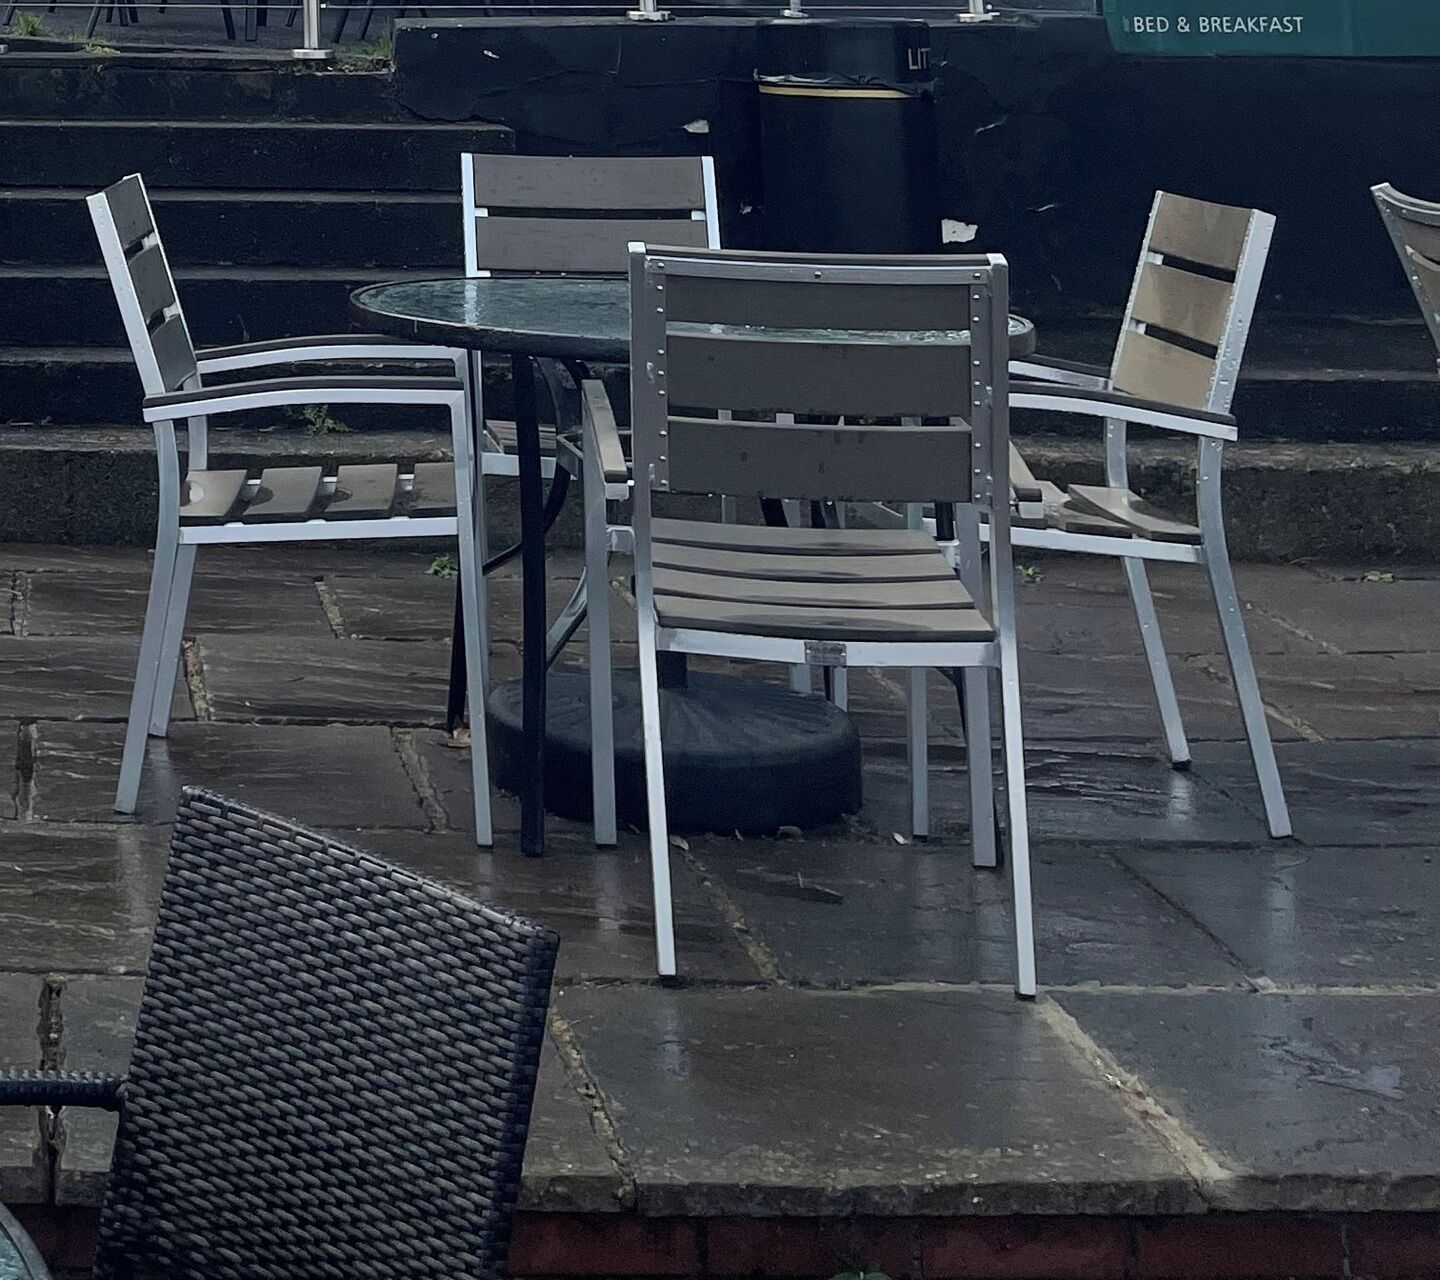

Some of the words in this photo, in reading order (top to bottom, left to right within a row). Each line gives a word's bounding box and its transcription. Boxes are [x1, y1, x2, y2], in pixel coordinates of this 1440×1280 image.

[1133, 15, 1170, 34] BED
[1176, 15, 1191, 34] &
[1198, 15, 1304, 34] BREAKFAST
